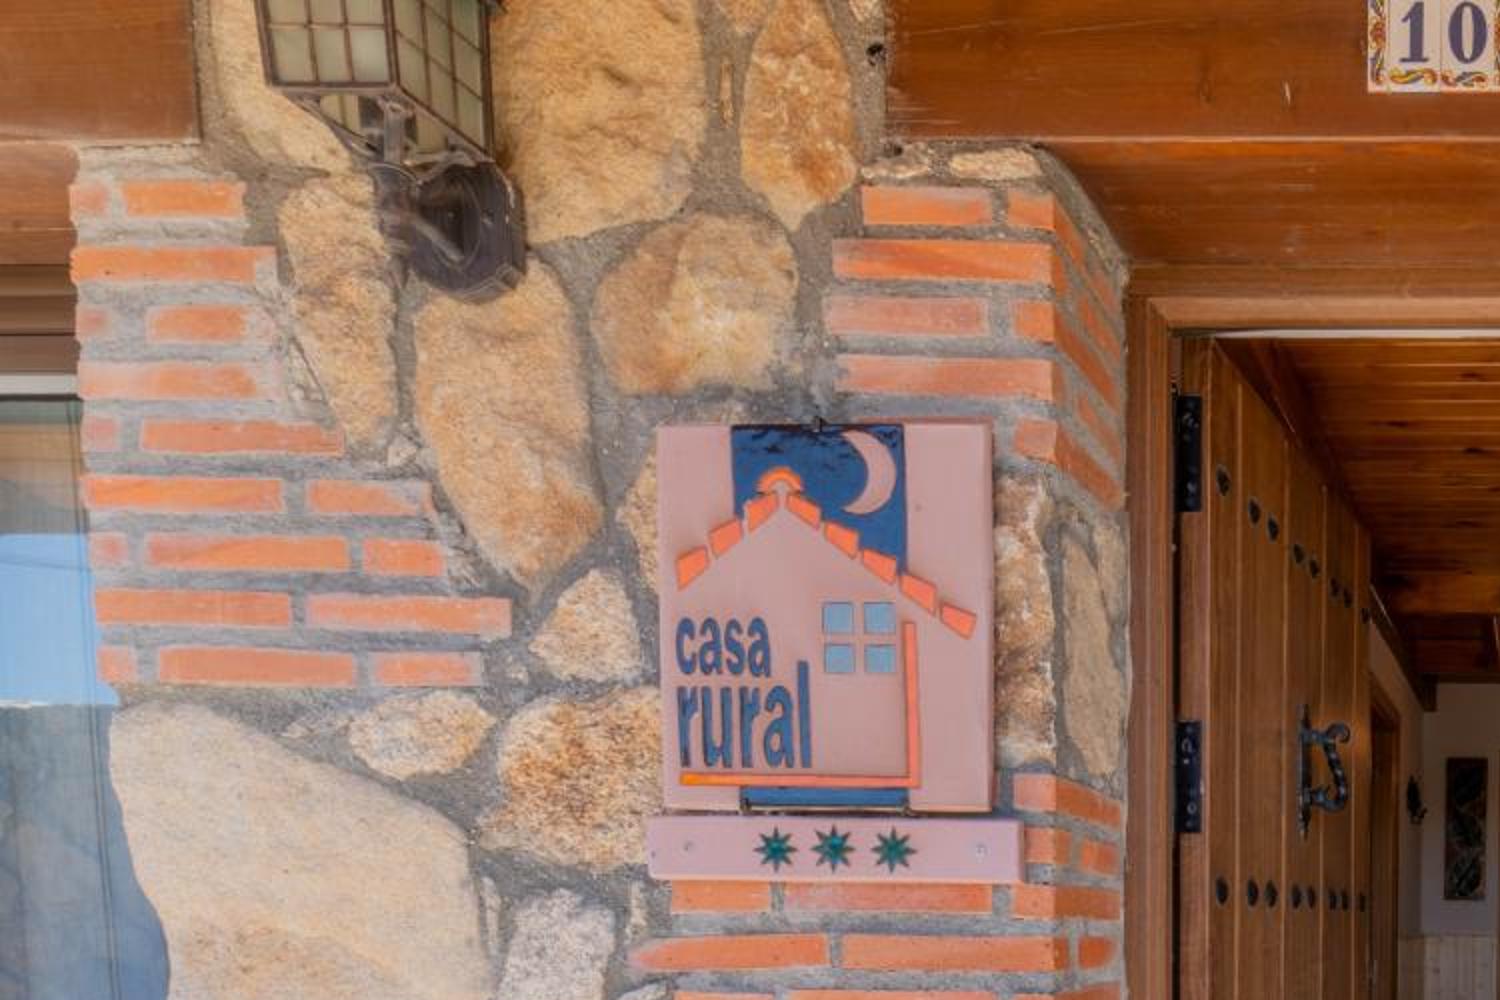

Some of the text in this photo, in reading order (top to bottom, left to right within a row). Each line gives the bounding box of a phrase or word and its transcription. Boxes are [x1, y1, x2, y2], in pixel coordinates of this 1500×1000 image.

[1400, 1, 1488, 64] 10
[676, 616, 771, 676] casa
[676, 660, 812, 769] rural
